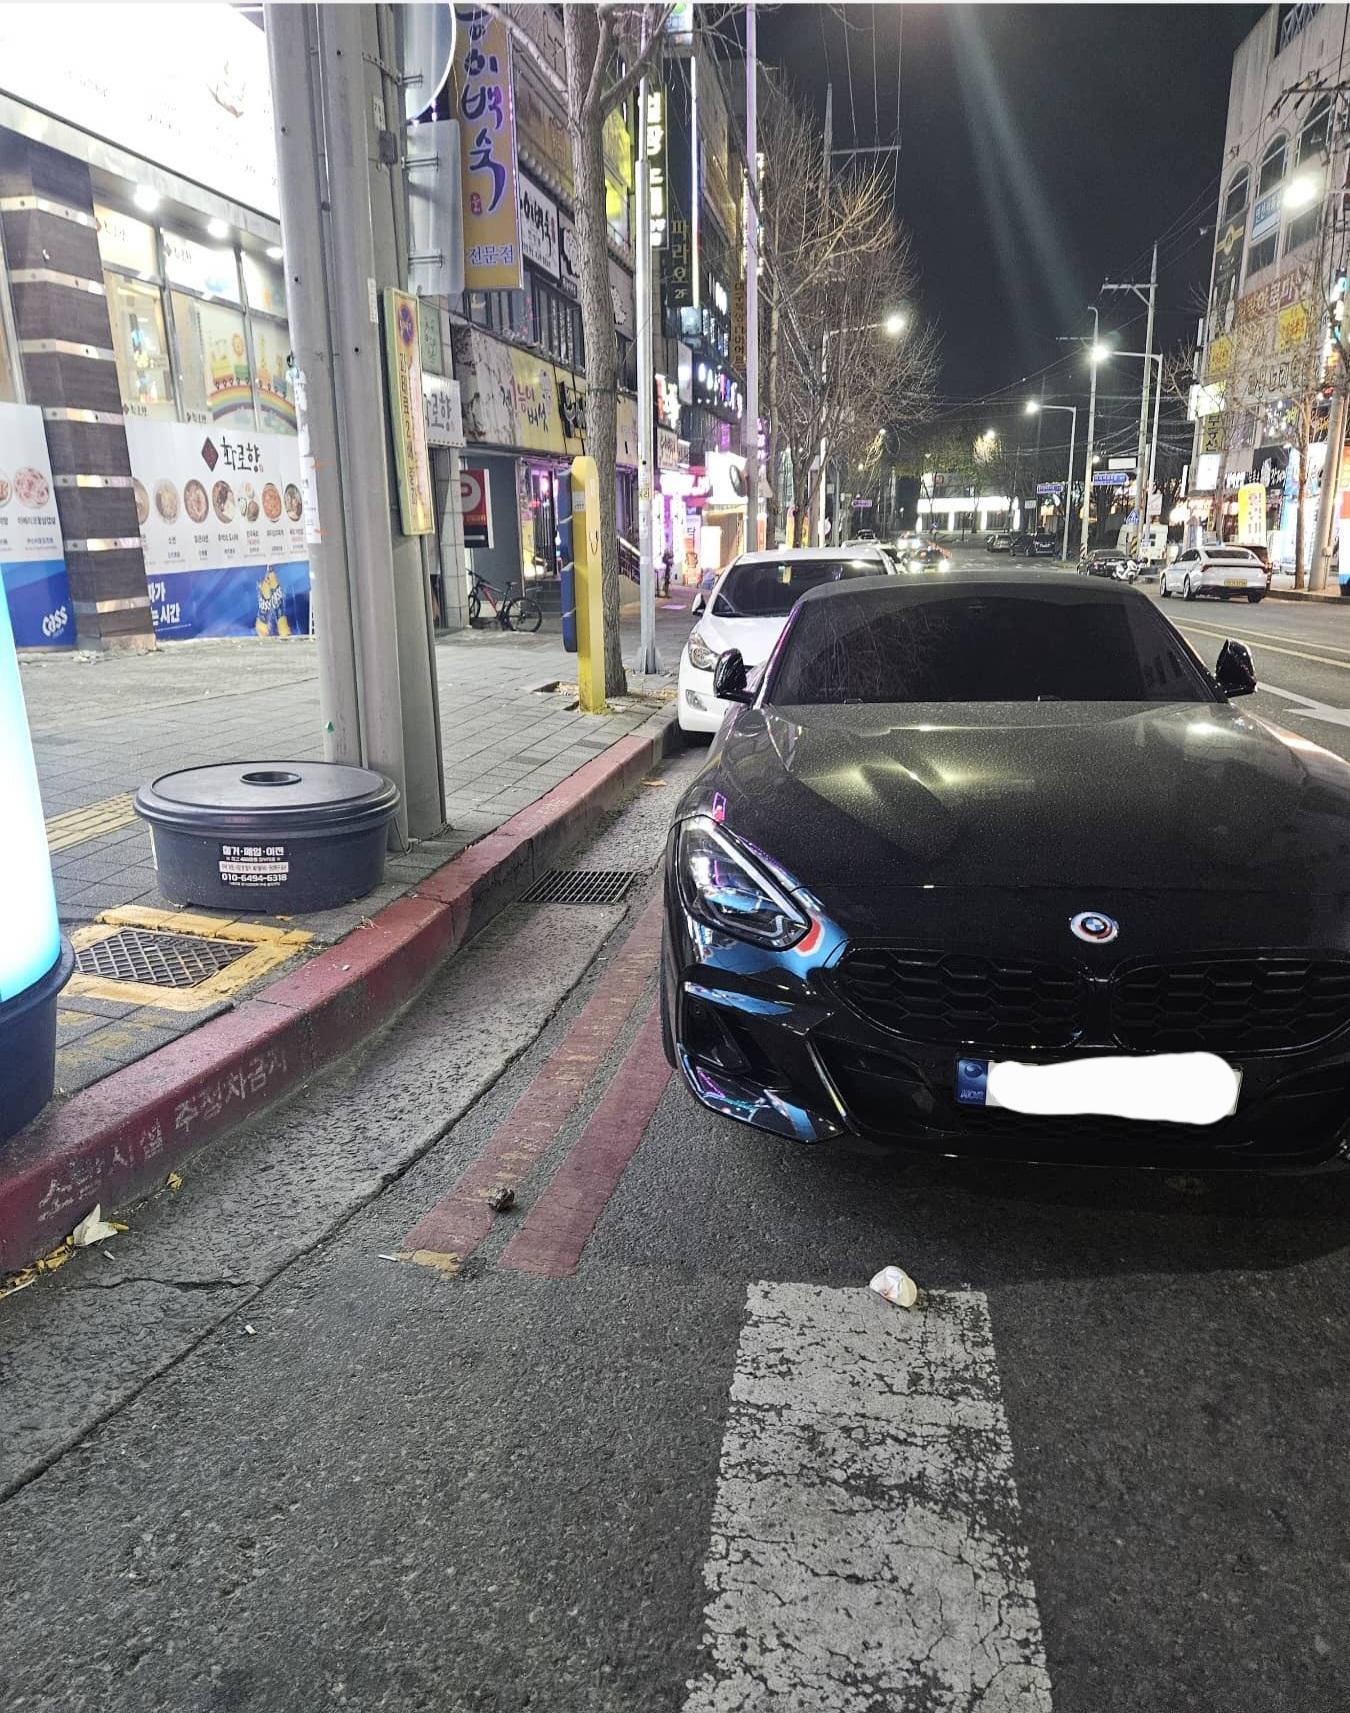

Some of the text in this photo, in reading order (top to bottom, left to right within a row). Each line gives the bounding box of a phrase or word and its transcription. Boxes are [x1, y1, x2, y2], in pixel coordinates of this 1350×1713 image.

[468, 245, 514, 265] 전문점
[674, 288, 688, 300] 2F
[219, 435, 261, 473] 화로향
[160, 602, 181, 624] 시간
[221, 872, 288, 883] 010-6494-6318
[174, 1048, 289, 1134] 주정차금지
